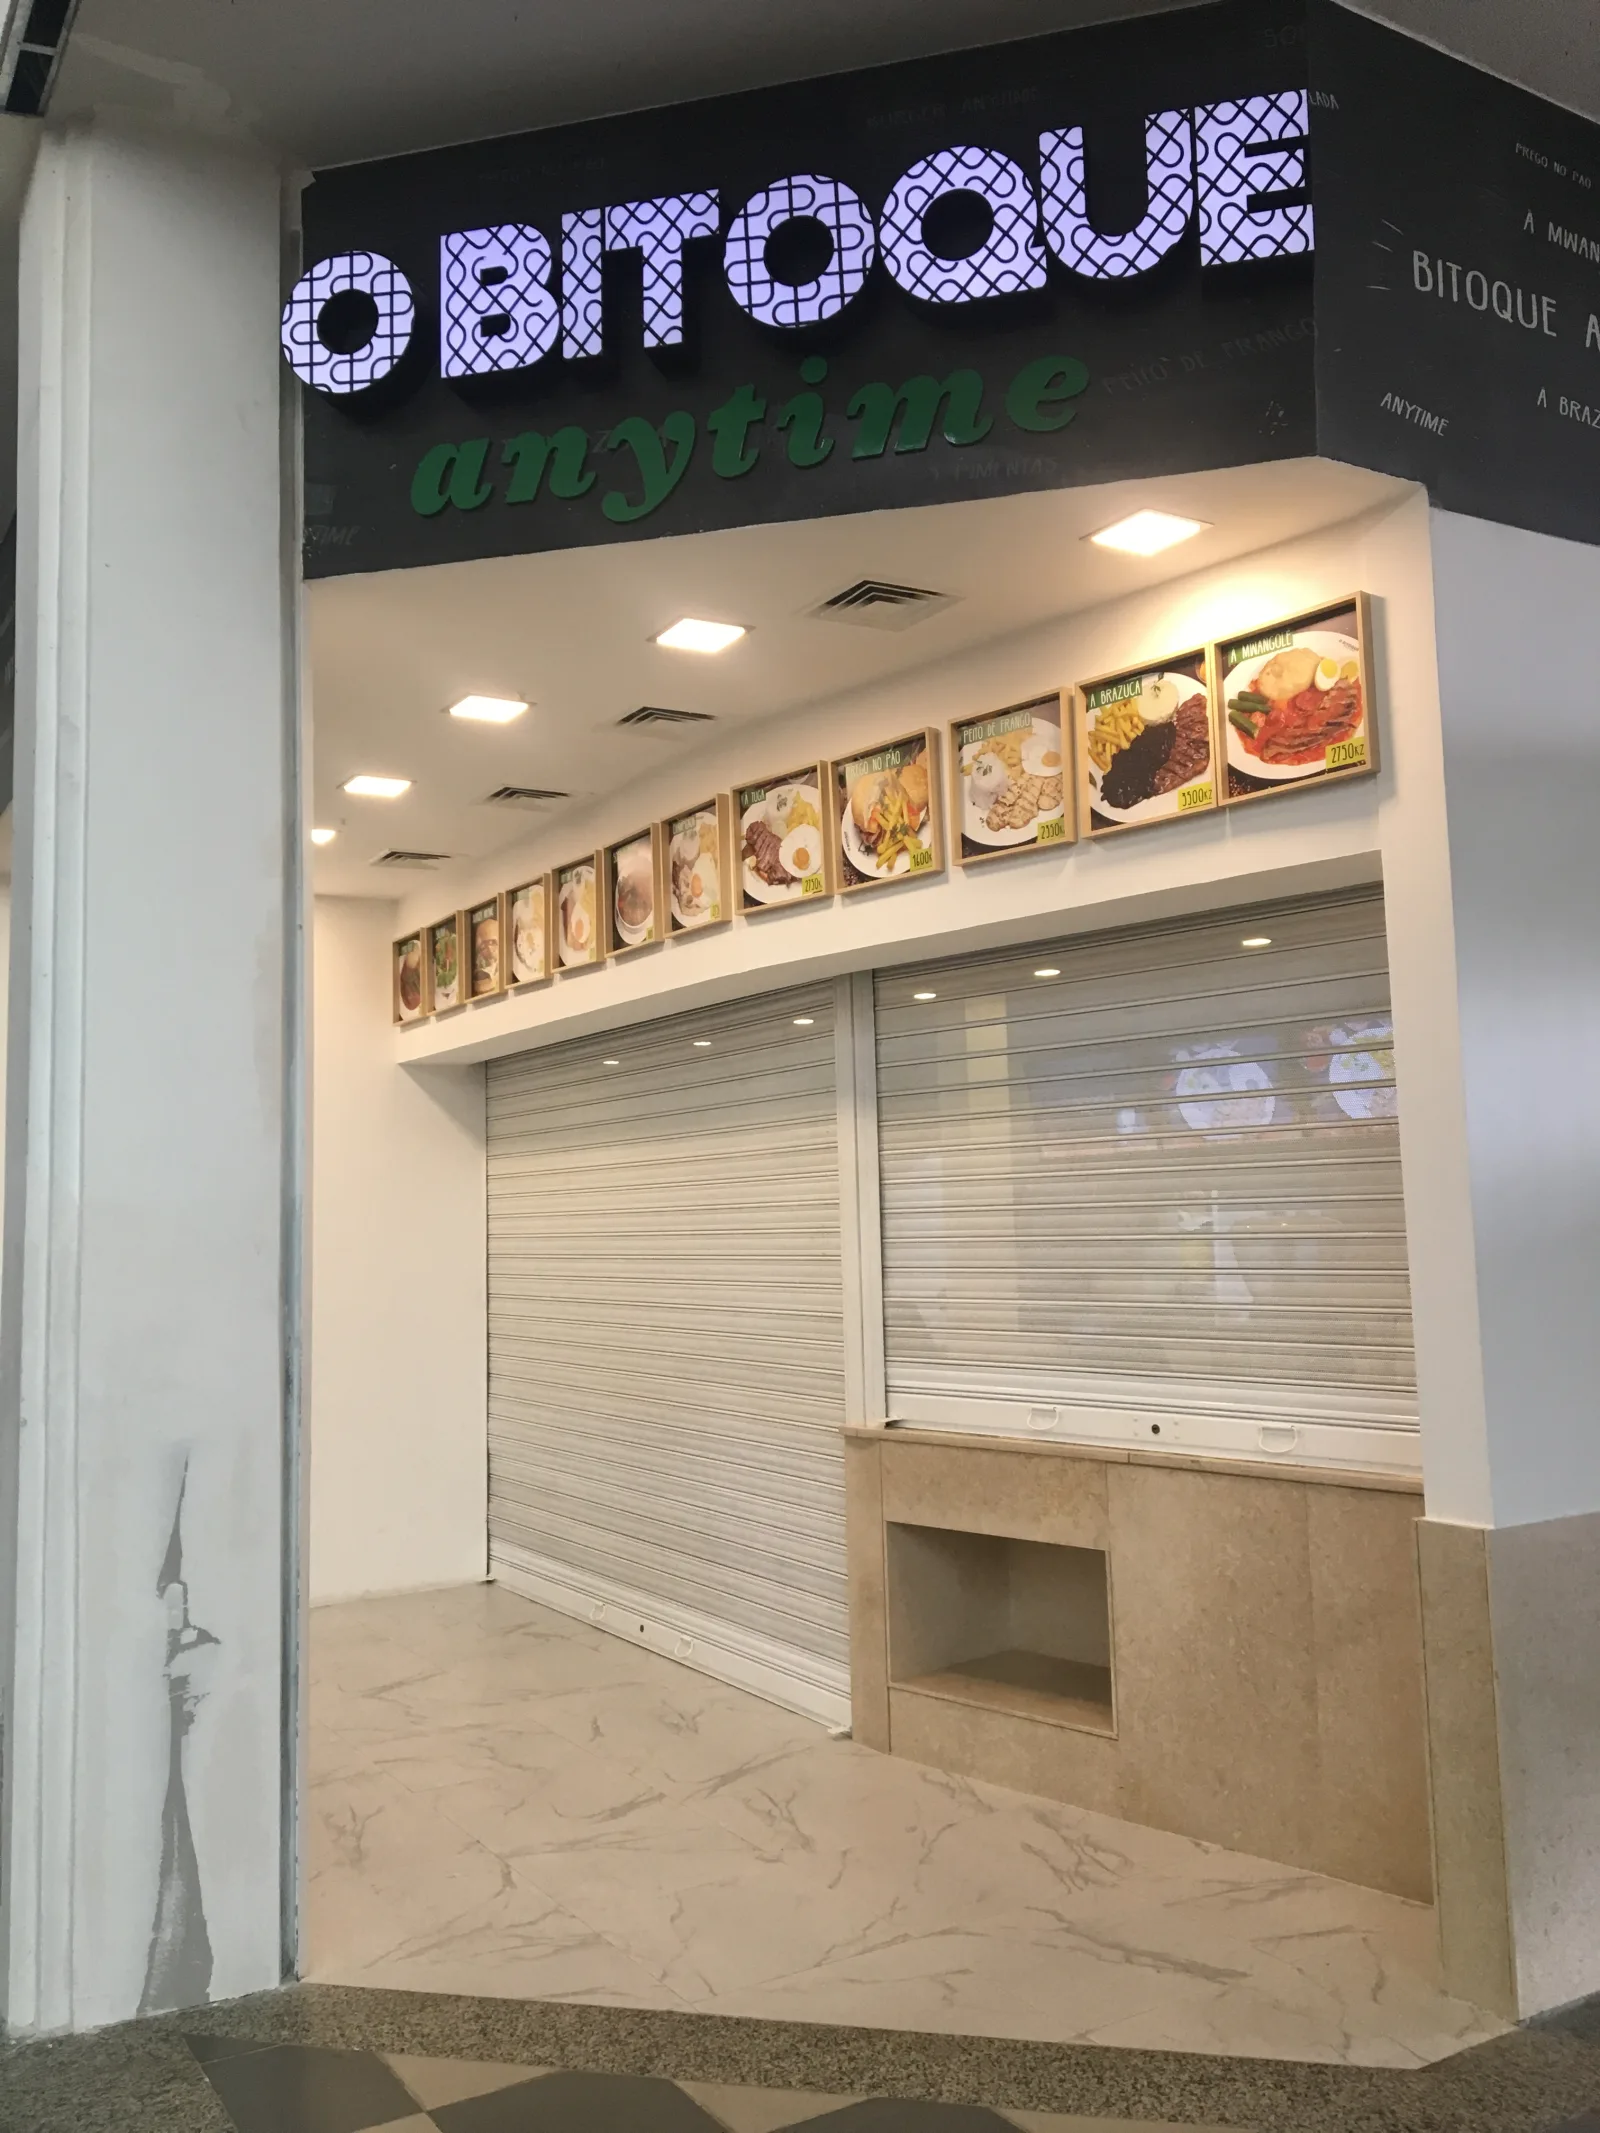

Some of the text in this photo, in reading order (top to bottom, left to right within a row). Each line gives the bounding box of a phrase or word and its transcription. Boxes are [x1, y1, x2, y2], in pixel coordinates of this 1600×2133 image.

[1515, 142, 1549, 168] PREGO
[1554, 161, 1567, 177] NO
[280, 88, 1315, 394] O BITOQUE
[1412, 250, 1557, 338] BITOQUE
[1380, 392, 1449, 437] ANYTIME
[410, 355, 1090, 523] anytime
[1100, 680, 1141, 705] BRAZUCA
[963, 712, 1032, 744] PEITO DE FRANGO
[872, 756, 882, 771] NO
[1331, 742, 1365, 764] 2750KZ
